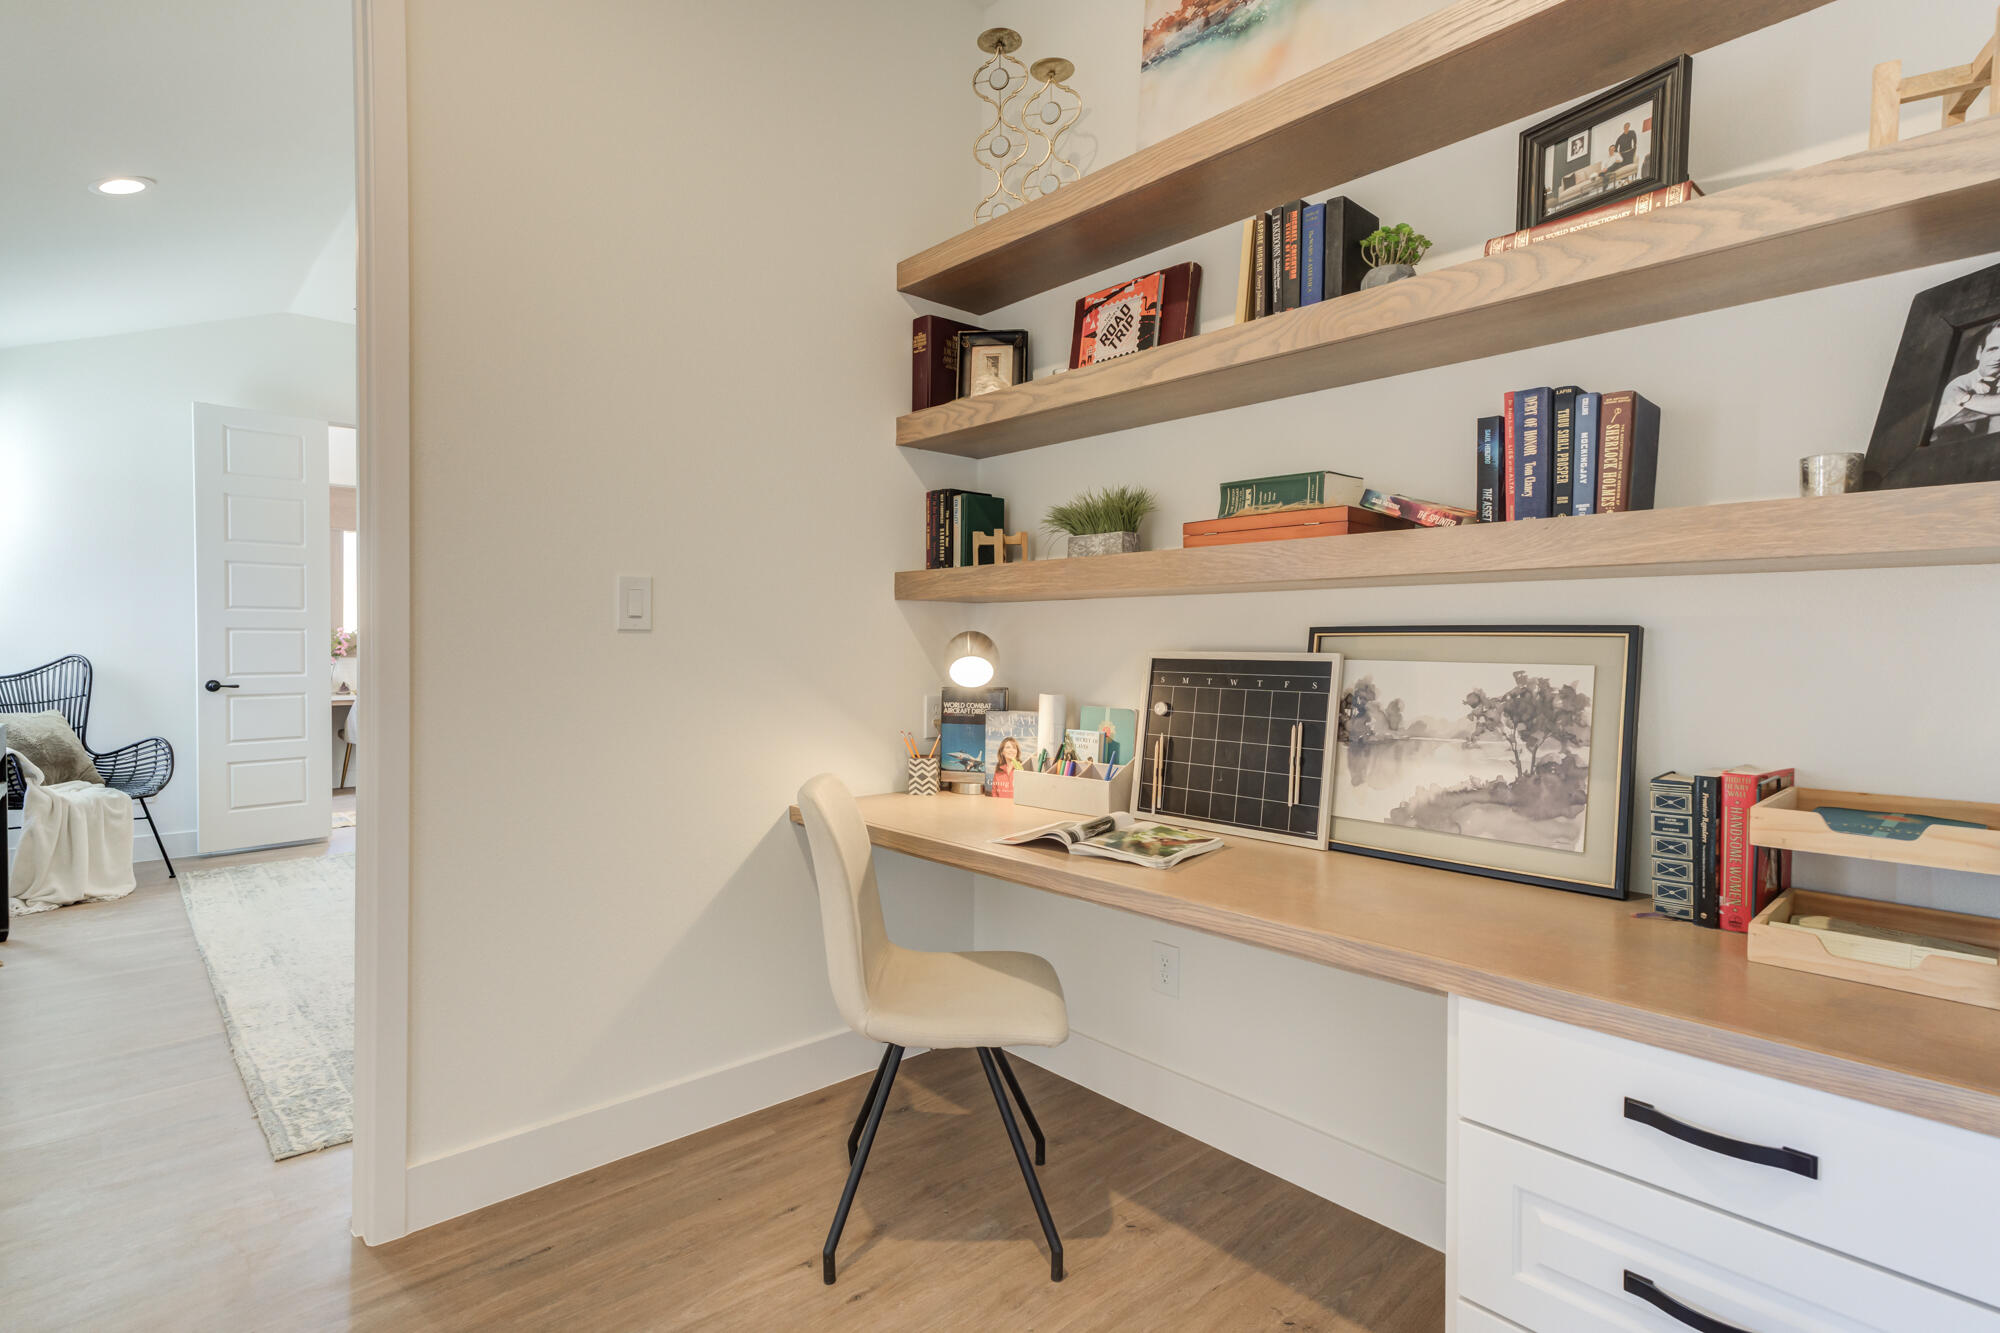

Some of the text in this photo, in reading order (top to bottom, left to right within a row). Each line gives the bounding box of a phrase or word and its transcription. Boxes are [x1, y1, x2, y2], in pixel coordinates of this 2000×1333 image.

[1256, 220, 1264, 245] ASPIRE
[1272, 220, 1280, 257] TAKEDOWN
[1532, 236, 1544, 244] THE
[1546, 228, 1569, 241] WORLD
[1588, 210, 1632, 229] DICTIONARY
[1256, 246, 1264, 272] HIGHER
[1289, 210, 1298, 280] MICHAEL CRICHTON
[1100, 304, 1131, 346] ROAD
[1108, 314, 1134, 350] TRIP
[1557, 408, 1570, 428] THOU
[1521, 395, 1538, 498] DEBT OF HONOR Tom Clancy
[1557, 429, 1570, 452] SHALL
[1604, 424, 1620, 470] SHERLOCK
[1556, 452, 1569, 484] PROSPER
[1579, 432, 1589, 484] MOCKINGJAY
[1482, 488, 1492, 522] THE ASSET
[1601, 472, 1618, 507] HOLMES
[1417, 510, 1457, 526] THE SPLINTER
[1160, 676, 1166, 684] S
[988, 714, 1036, 724] SARAH
[988, 728, 1036, 737] PALIN
[987, 779, 1010, 788] Going
[1727, 790, 1746, 798] WALL
[1729, 806, 1744, 864] HANDSOME
[1728, 865, 1742, 906] WOMEN
